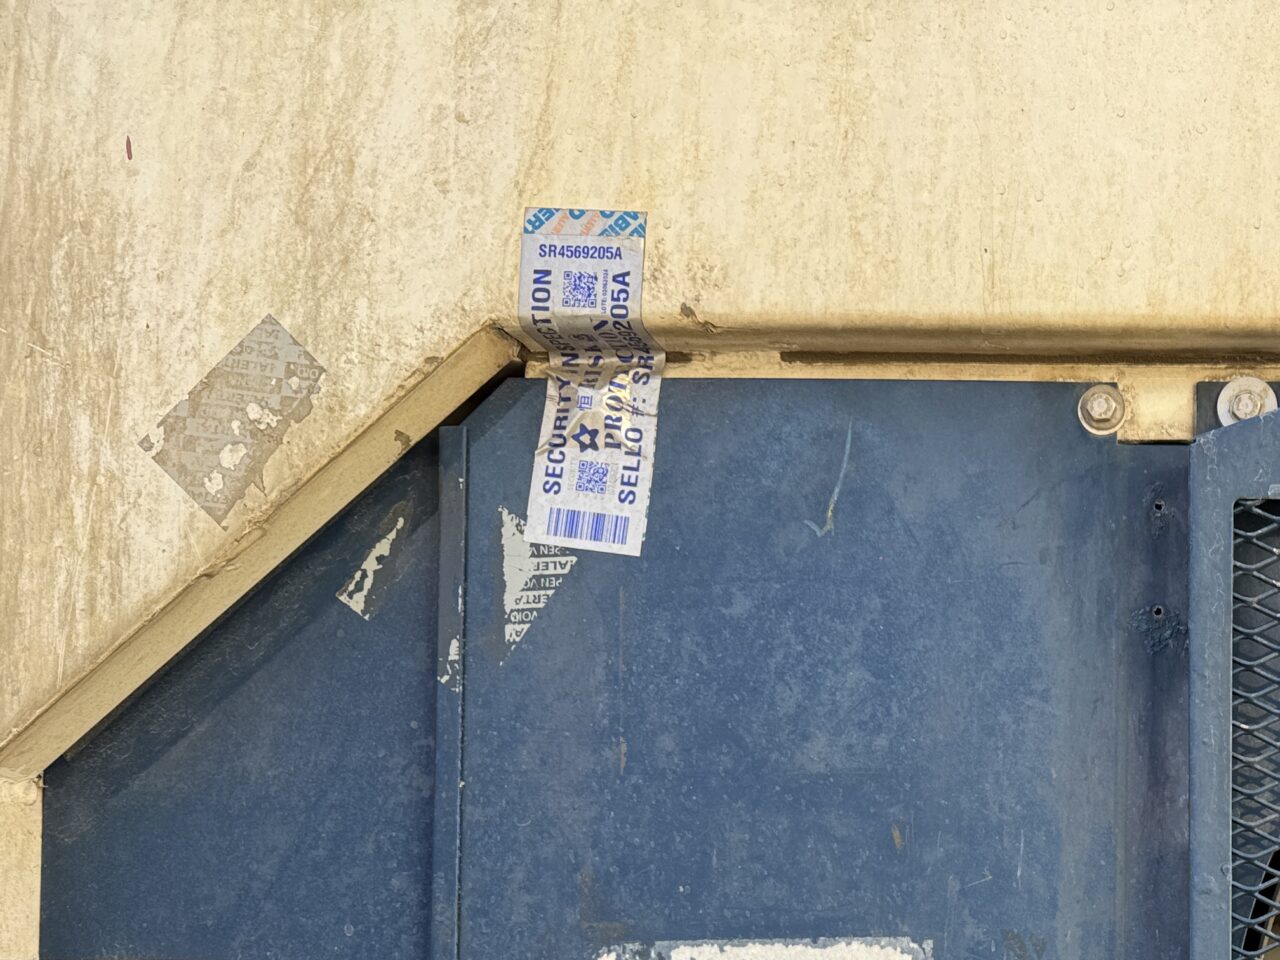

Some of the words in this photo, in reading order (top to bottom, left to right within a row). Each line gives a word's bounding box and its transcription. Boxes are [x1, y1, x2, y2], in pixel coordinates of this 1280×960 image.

[539, 244, 623, 260] SR4569205A
[531, 269, 580, 374] INSPECTION
[610, 271, 654, 386] SR4569205A
[543, 375, 572, 495] SECURITY
[618, 427, 643, 505] SELLO
